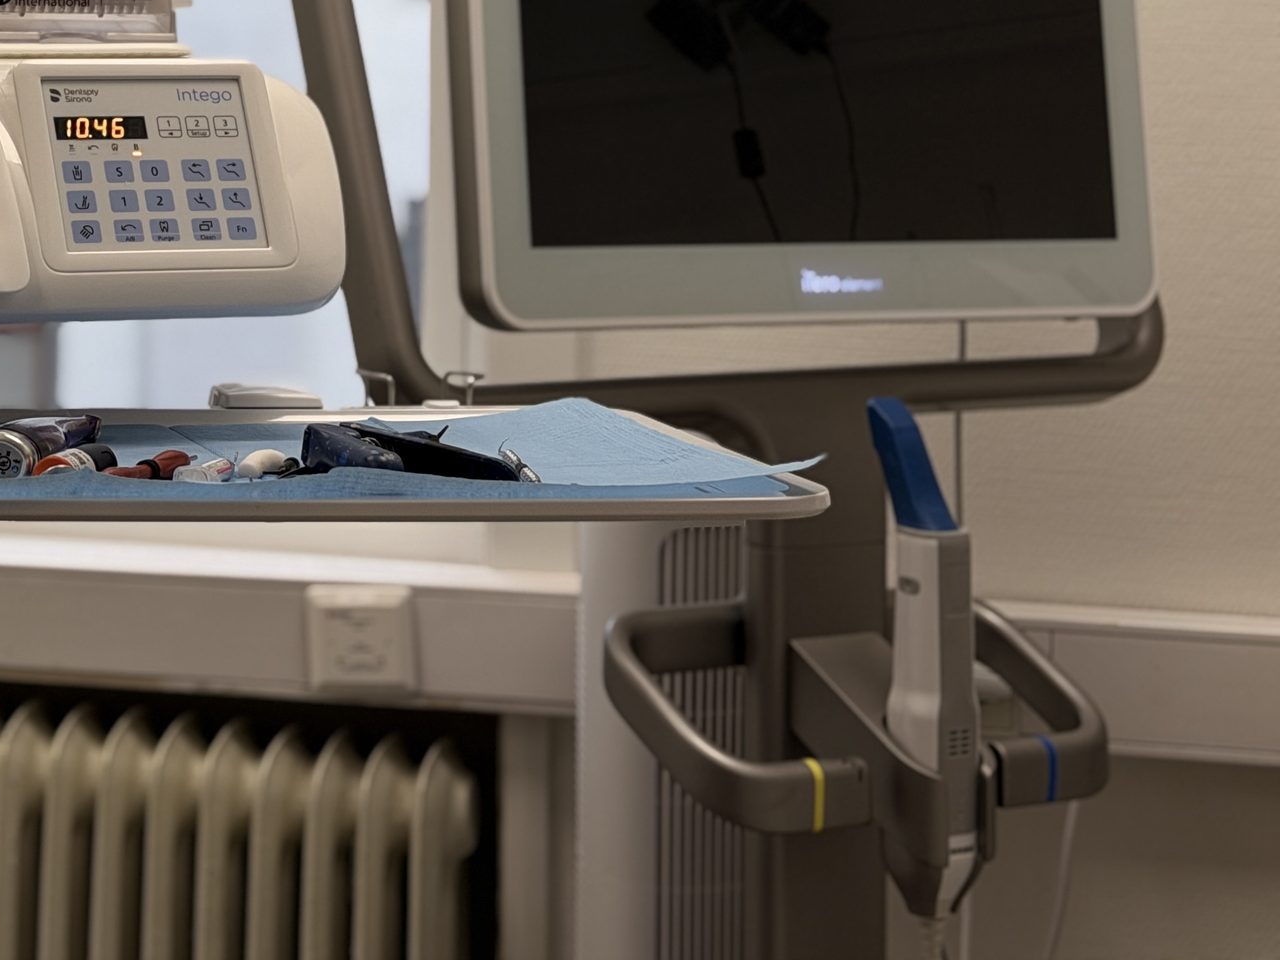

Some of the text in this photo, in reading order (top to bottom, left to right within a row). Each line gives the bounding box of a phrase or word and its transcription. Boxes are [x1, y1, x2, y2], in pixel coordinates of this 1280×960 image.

[63, 88, 99, 96] Dentsply
[176, 88, 232, 104] Intego
[67, 117, 125, 138] 10.46
[222, 119, 228, 127] 3
[115, 167, 123, 177] S
[121, 196, 127, 207] 1
[156, 195, 164, 206] 2
[236, 225, 248, 233] Fn
